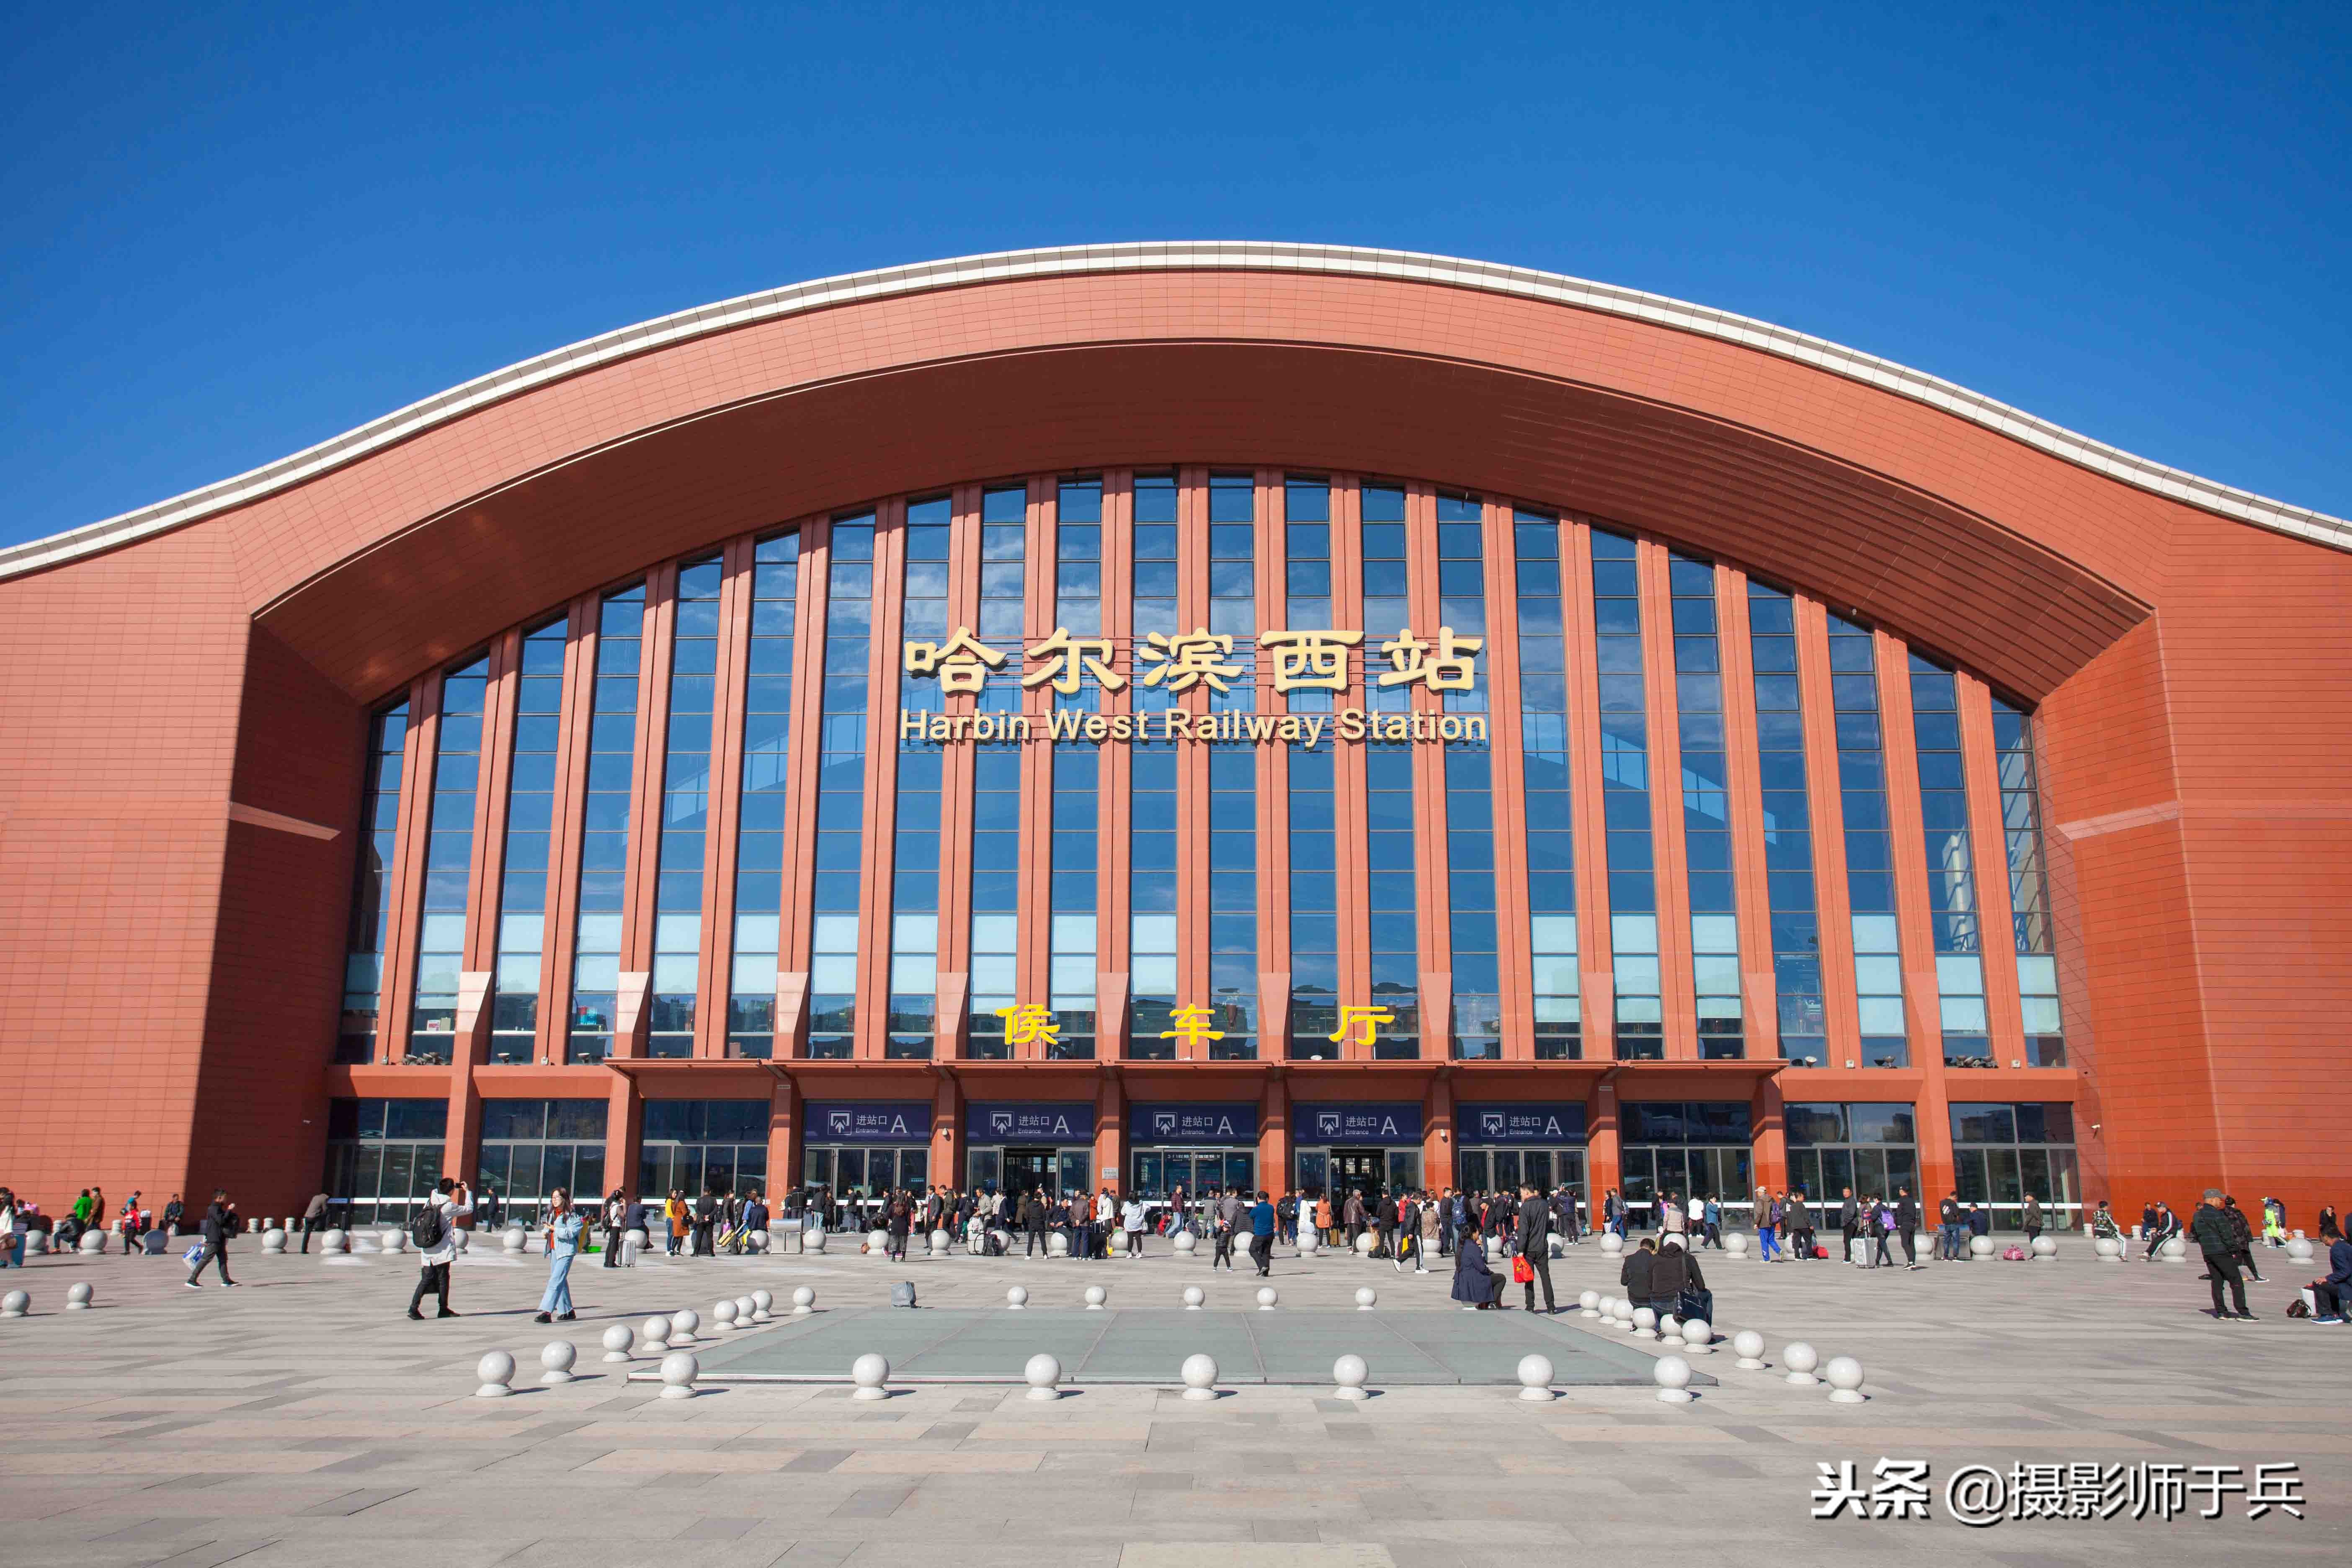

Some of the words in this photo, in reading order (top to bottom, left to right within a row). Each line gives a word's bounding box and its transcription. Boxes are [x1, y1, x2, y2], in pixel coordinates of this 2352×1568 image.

[904, 626, 1483, 694] 哈尔滨西站
[900, 707, 1030, 740] Harbin
[1045, 708, 1149, 740] West
[1165, 707, 1325, 748] Railway
[1339, 707, 1487, 740] Station
[995, 1004, 1395, 1046] 候车厅
[856, 1114, 887, 1125] 进站口
[890, 1115, 907, 1133] A
[1019, 1115, 1050, 1126] 进站口
[1053, 1115, 1070, 1134] A
[1182, 1116, 1214, 1127] 进站口
[1217, 1116, 1233, 1135] A
[1346, 1116, 1378, 1127] 进站口
[1381, 1116, 1398, 1135] A
[1510, 1116, 1542, 1127] 进站口
[1545, 1117, 1561, 1135] A
